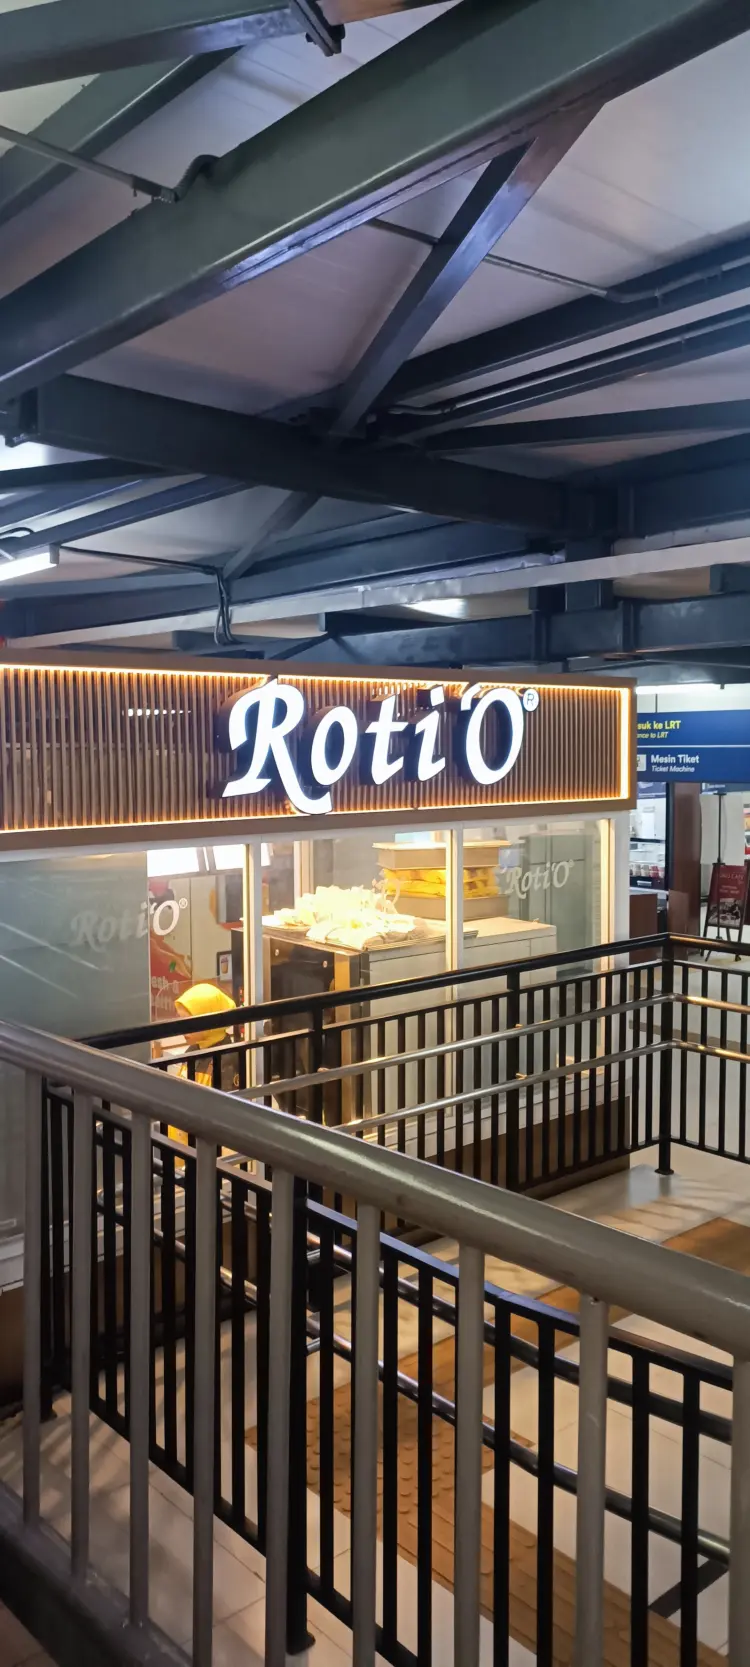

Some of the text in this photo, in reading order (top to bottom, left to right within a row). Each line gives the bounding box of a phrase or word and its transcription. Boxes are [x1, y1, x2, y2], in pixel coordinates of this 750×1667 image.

[637, 720, 682, 730] suk ke LRT
[657, 731, 669, 739] LRT
[650, 754, 700, 764] Mesin Tiket
[669, 765, 695, 773] Machine
